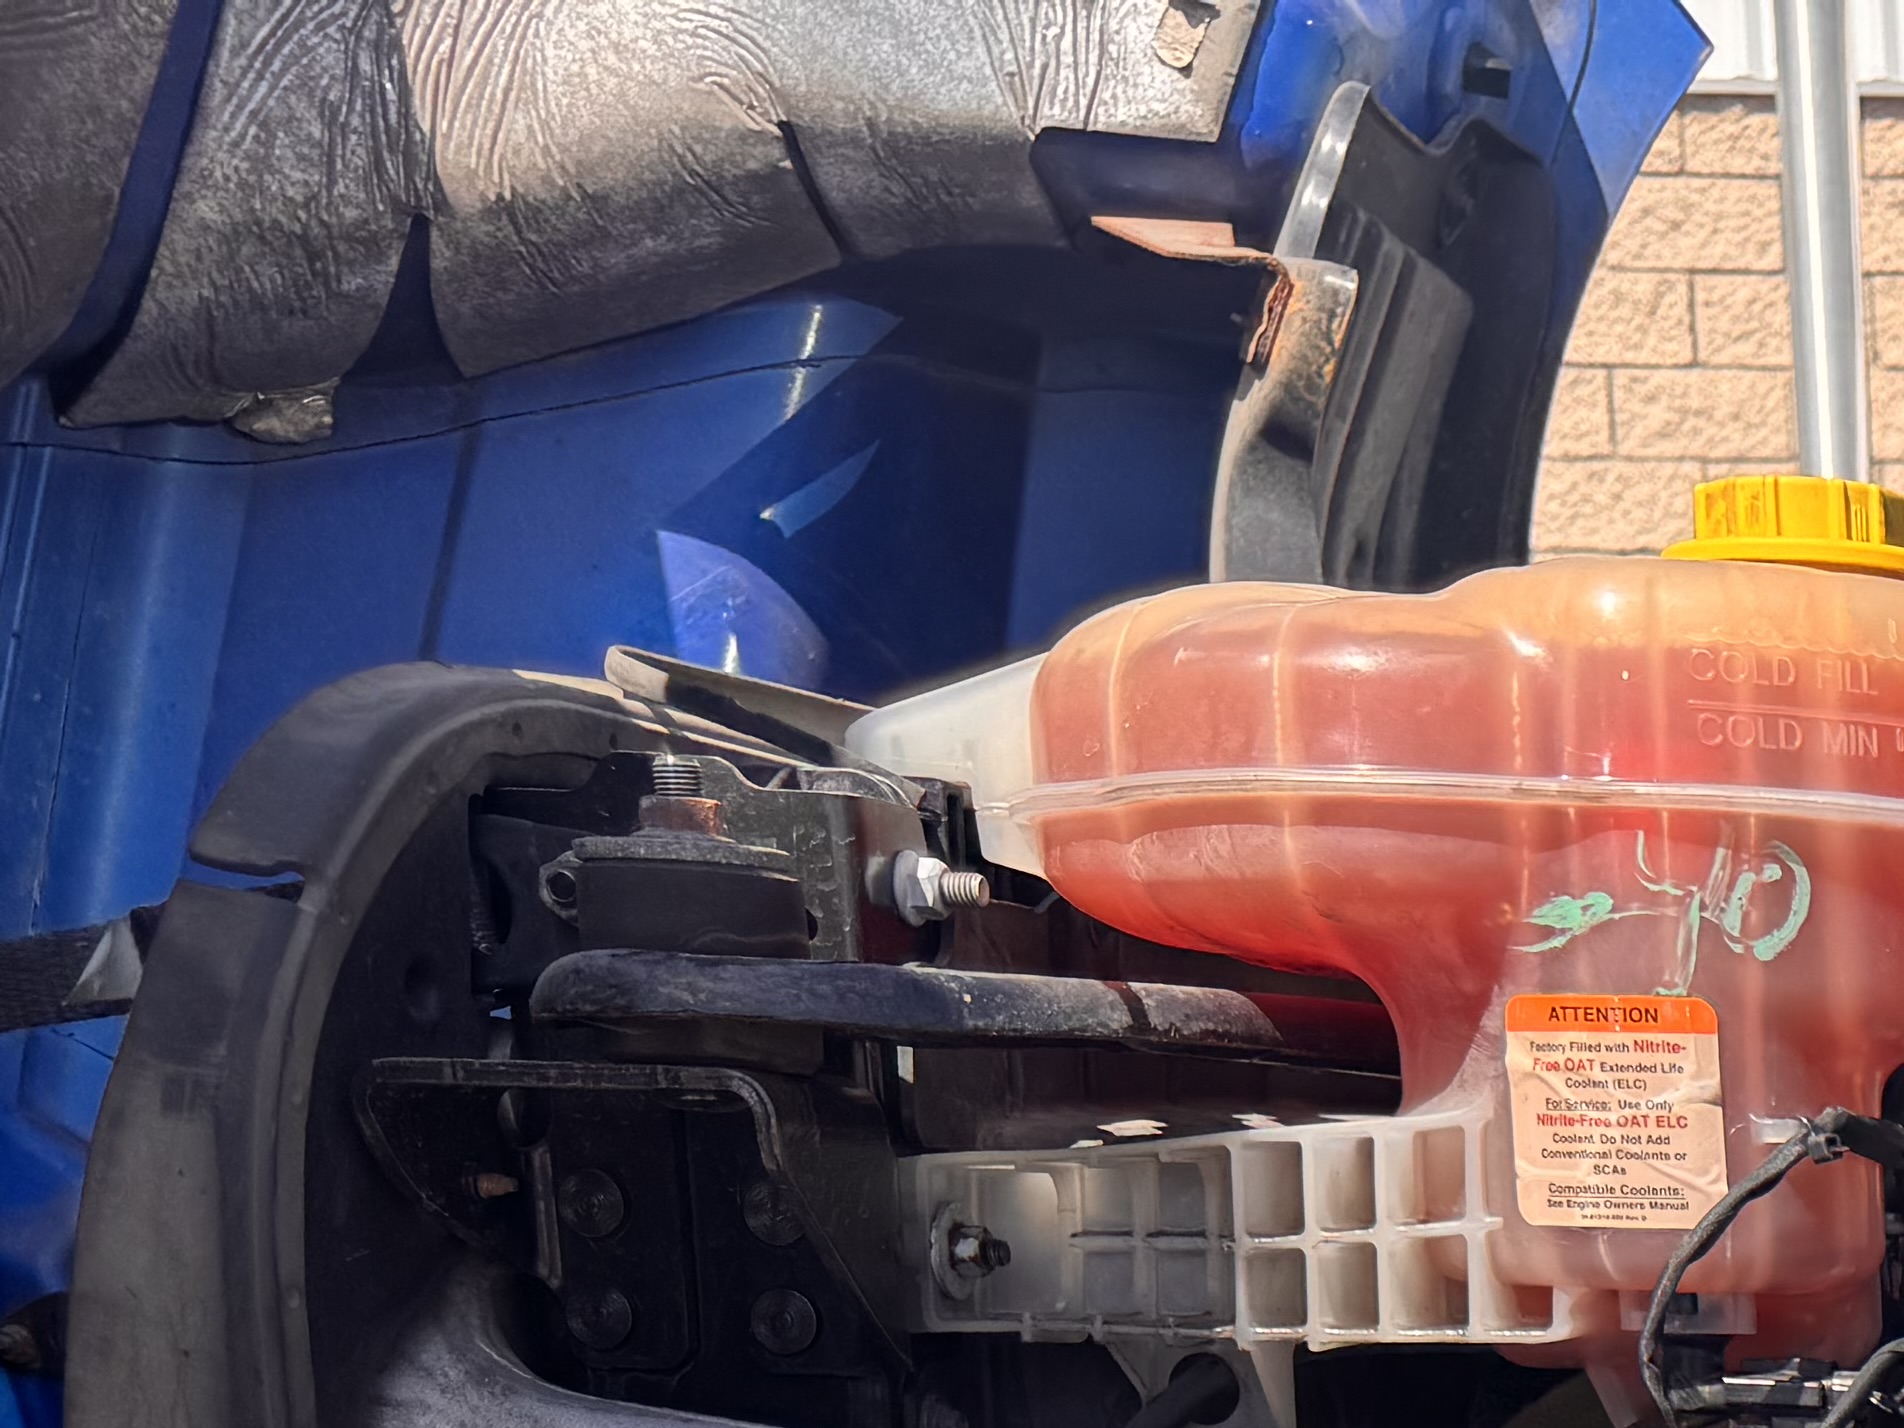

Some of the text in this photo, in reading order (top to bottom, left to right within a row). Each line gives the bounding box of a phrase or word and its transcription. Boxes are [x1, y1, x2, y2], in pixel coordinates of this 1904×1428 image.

[1687, 648, 1880, 696] COLD FILL
[1697, 712, 1880, 759] COLD MIN
[1548, 1006, 1659, 1024] ATTENTION
[1530, 1040, 1687, 1054] Factory Filled with Nitrite-
[1533, 1058, 1684, 1074] Free OAT Extended Life
[1565, 1078, 1648, 1092] Coolant (ELC)
[1618, 1100, 1642, 1111] Use
[1646, 1100, 1674, 1113] Only
[1537, 1114, 1689, 1129] Nitrite-Free OAT ELC
[1552, 1133, 1671, 1145] Coolant Do Not Add
[1541, 1149, 1688, 1161] Conventional Coolants or
[1593, 1164, 1627, 1176] SCAs
[1548, 1183, 1685, 1198] Compatible Coolants:
[1547, 1199, 1689, 1211] See Engine Owners Manual
